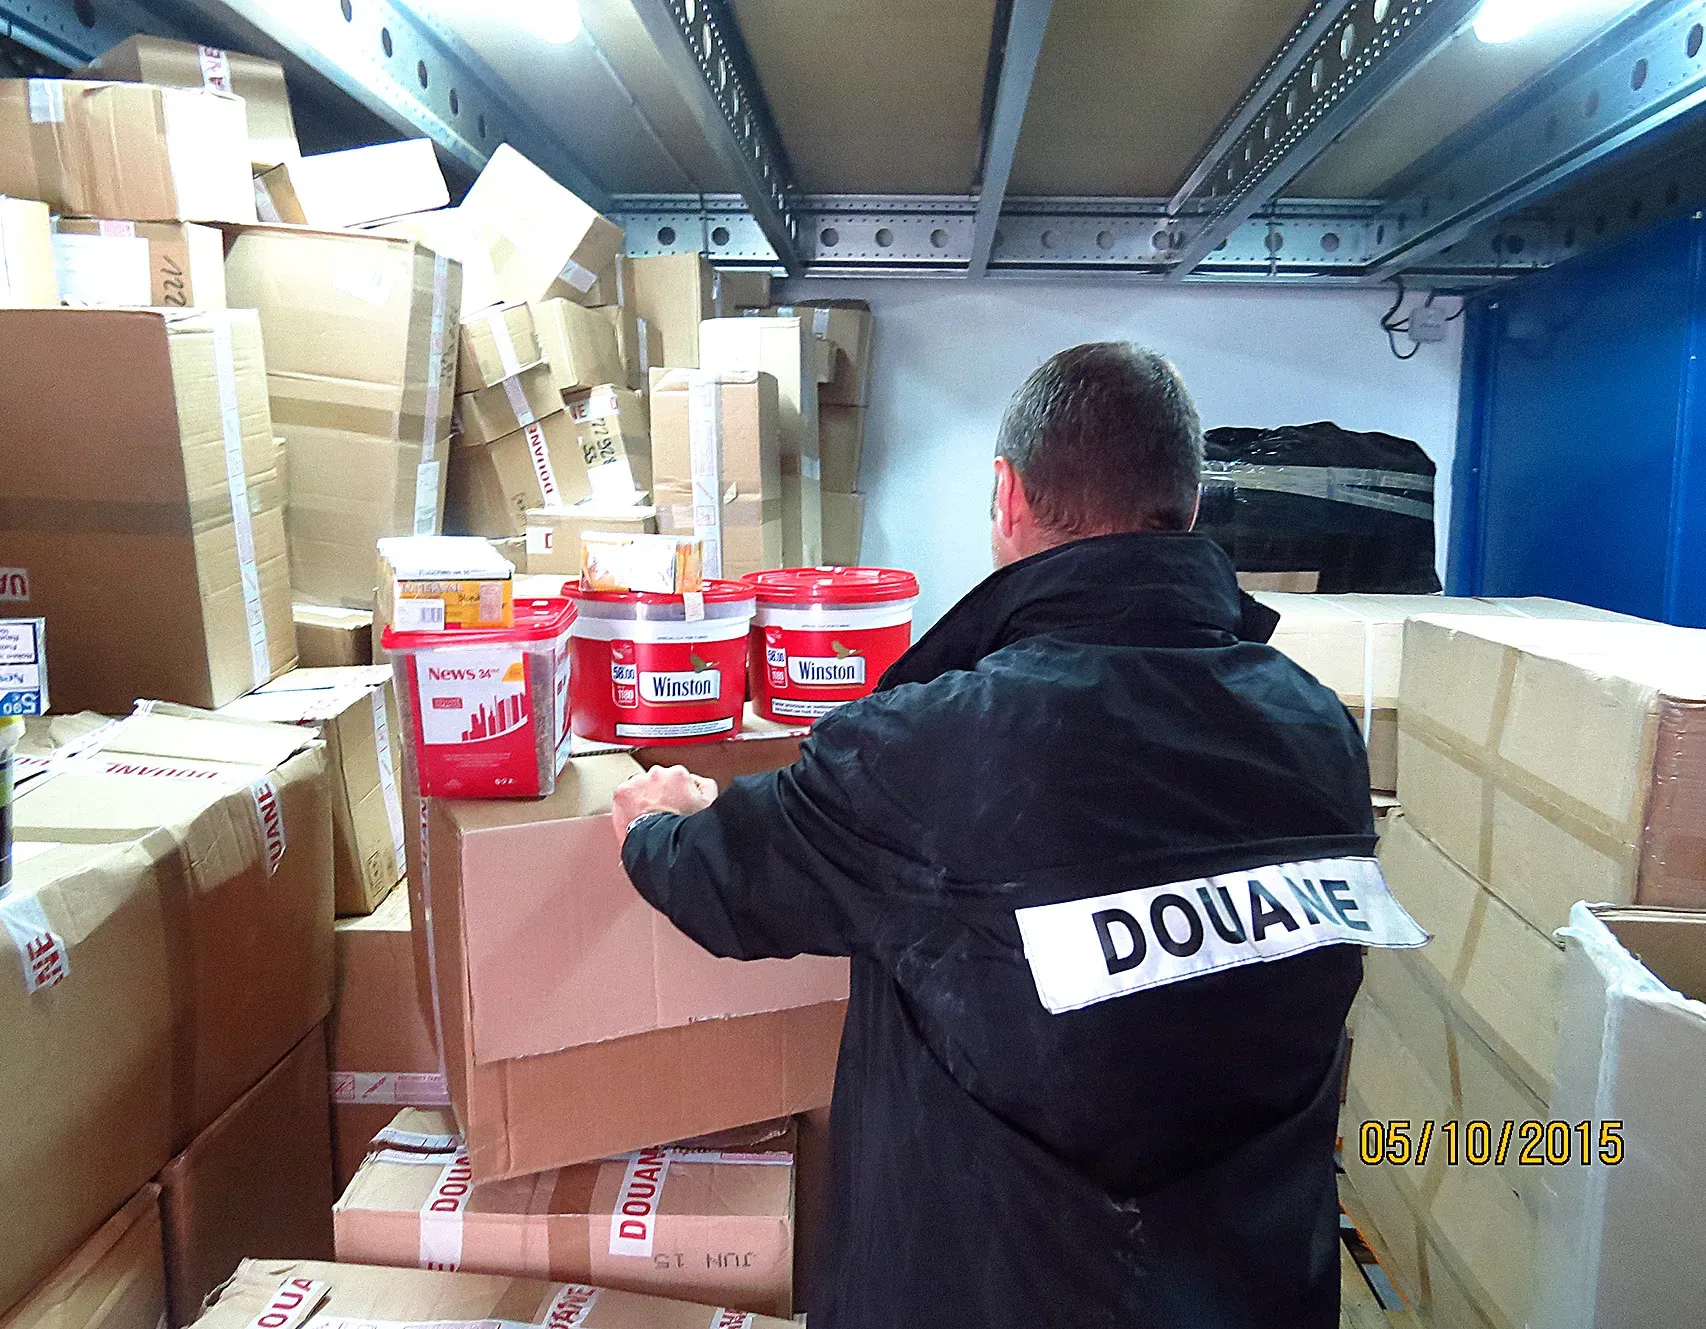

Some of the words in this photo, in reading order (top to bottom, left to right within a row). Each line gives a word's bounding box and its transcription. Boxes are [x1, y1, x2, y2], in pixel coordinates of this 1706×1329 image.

[527, 425, 554, 494] DOUANE
[428, 667, 476, 681] News
[799, 660, 855, 681] Winston
[652, 675, 711, 698] Winston
[106, 763, 218, 779] DOUANE
[1091, 879, 1373, 976] DOUANE
